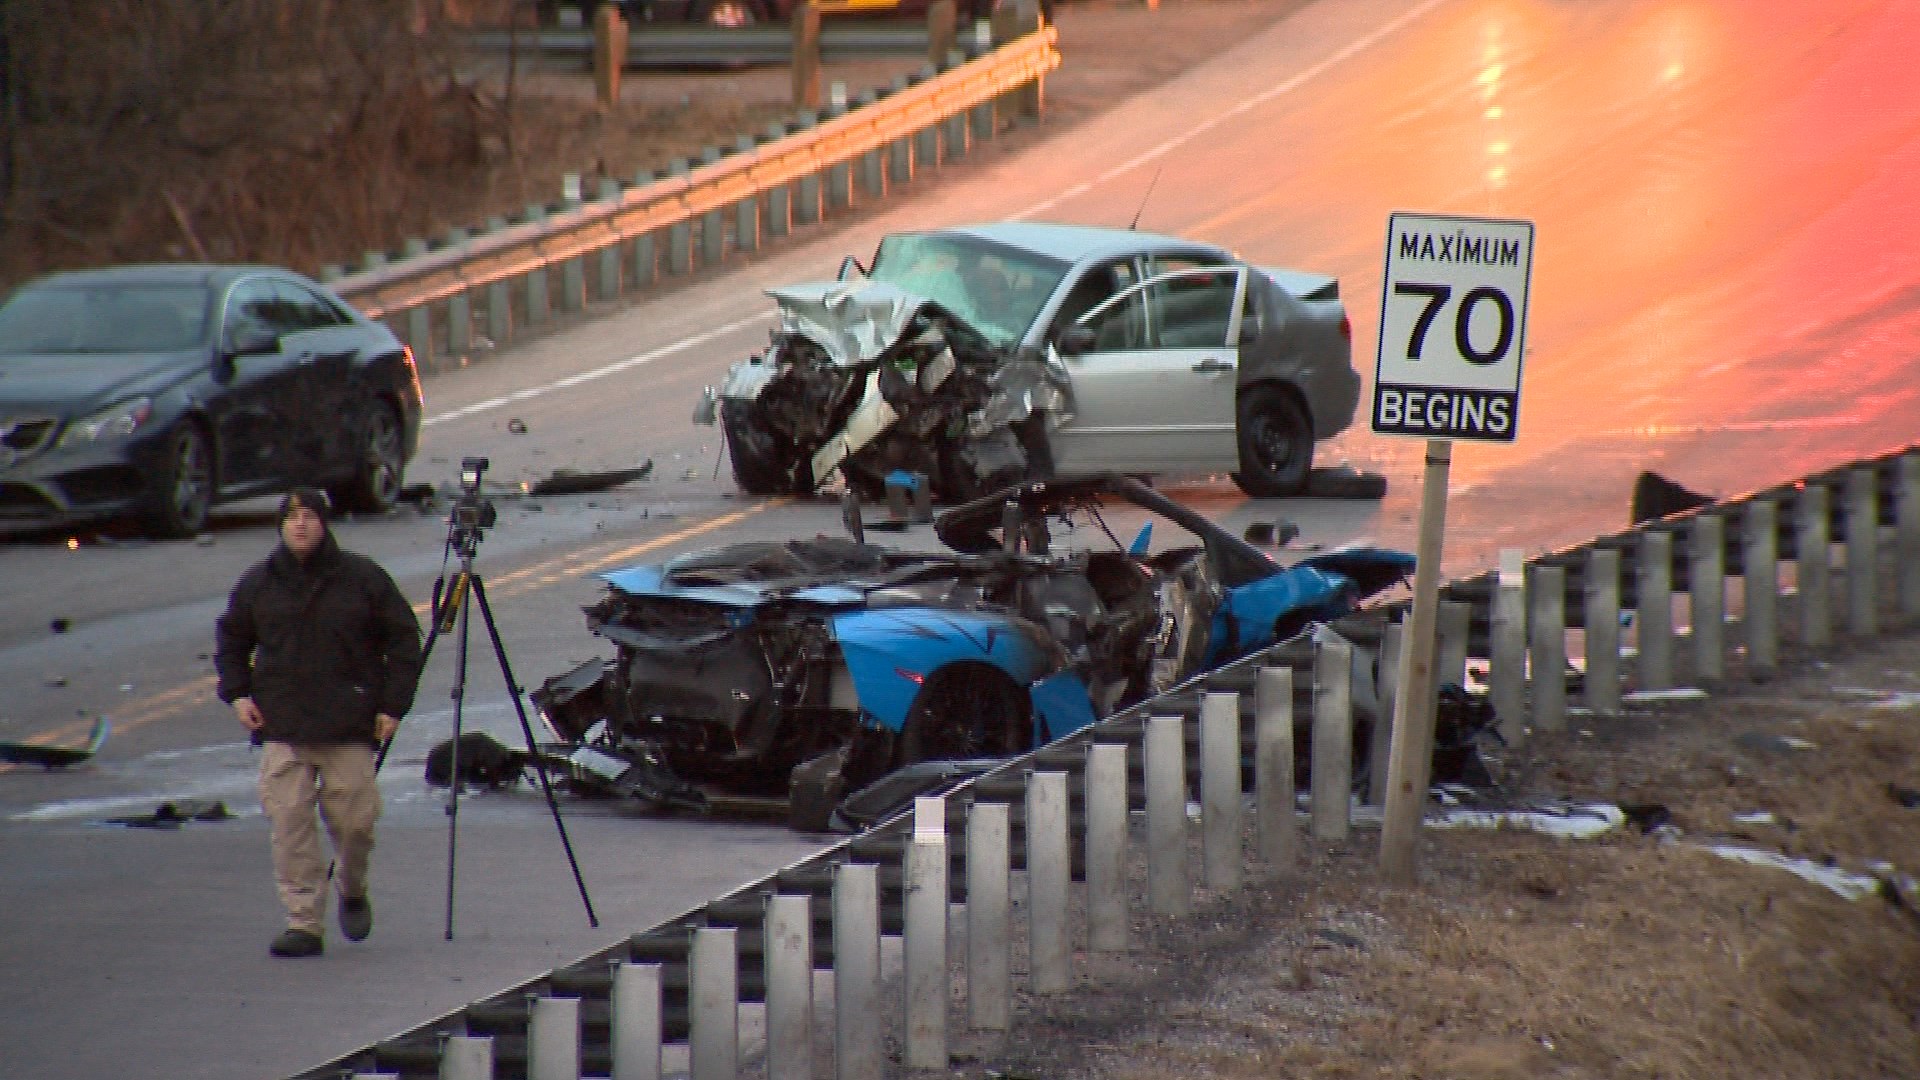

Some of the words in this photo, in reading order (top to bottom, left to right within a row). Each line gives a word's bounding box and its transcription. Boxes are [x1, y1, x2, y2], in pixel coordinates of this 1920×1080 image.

[1400, 232, 1519, 266] MAXIMUM
[1394, 282, 1515, 366] 70
[1379, 390, 1511, 432] BEGINS
